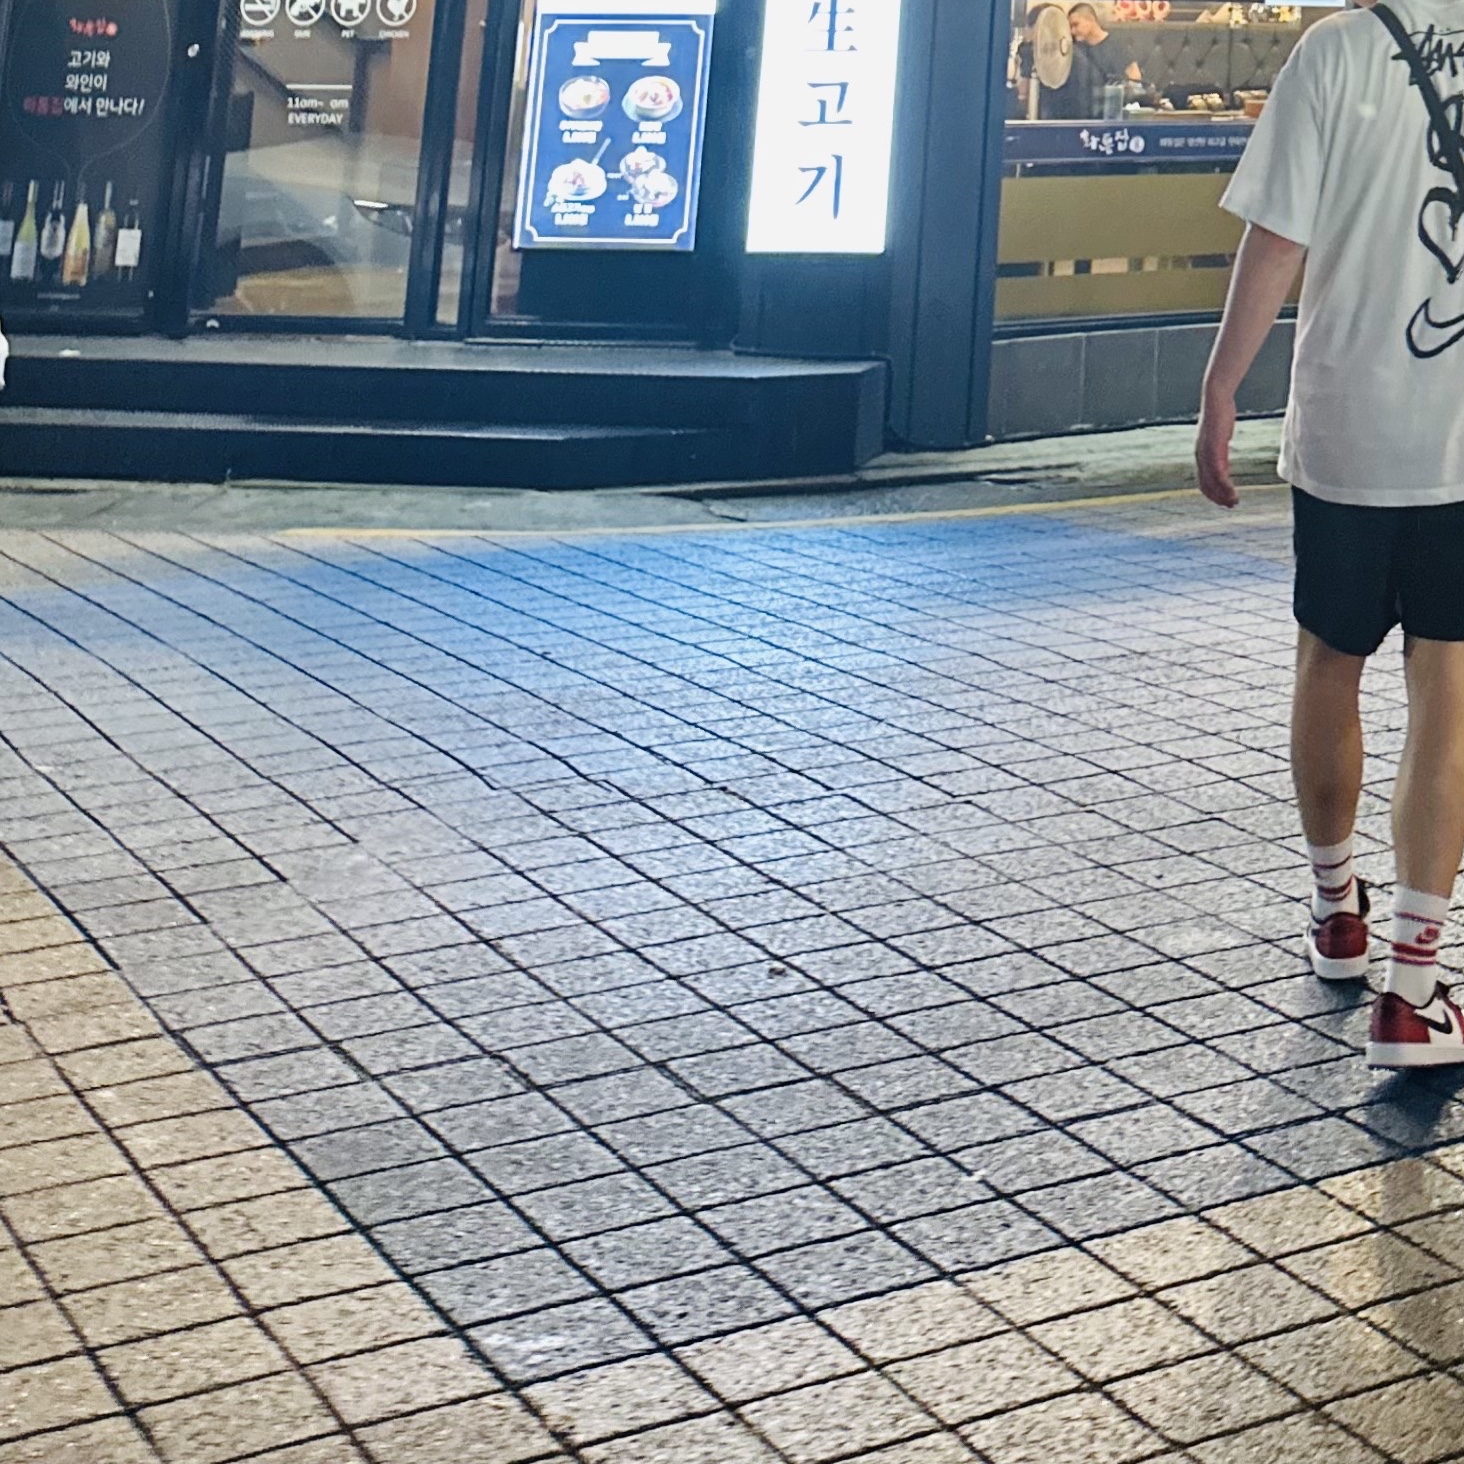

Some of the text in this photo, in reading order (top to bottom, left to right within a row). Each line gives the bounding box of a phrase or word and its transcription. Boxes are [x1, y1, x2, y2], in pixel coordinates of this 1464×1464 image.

[67, 49, 111, 69] 고기와
[64, 73, 108, 92] 와인이
[287, 112, 343, 124] EVERYDAY
